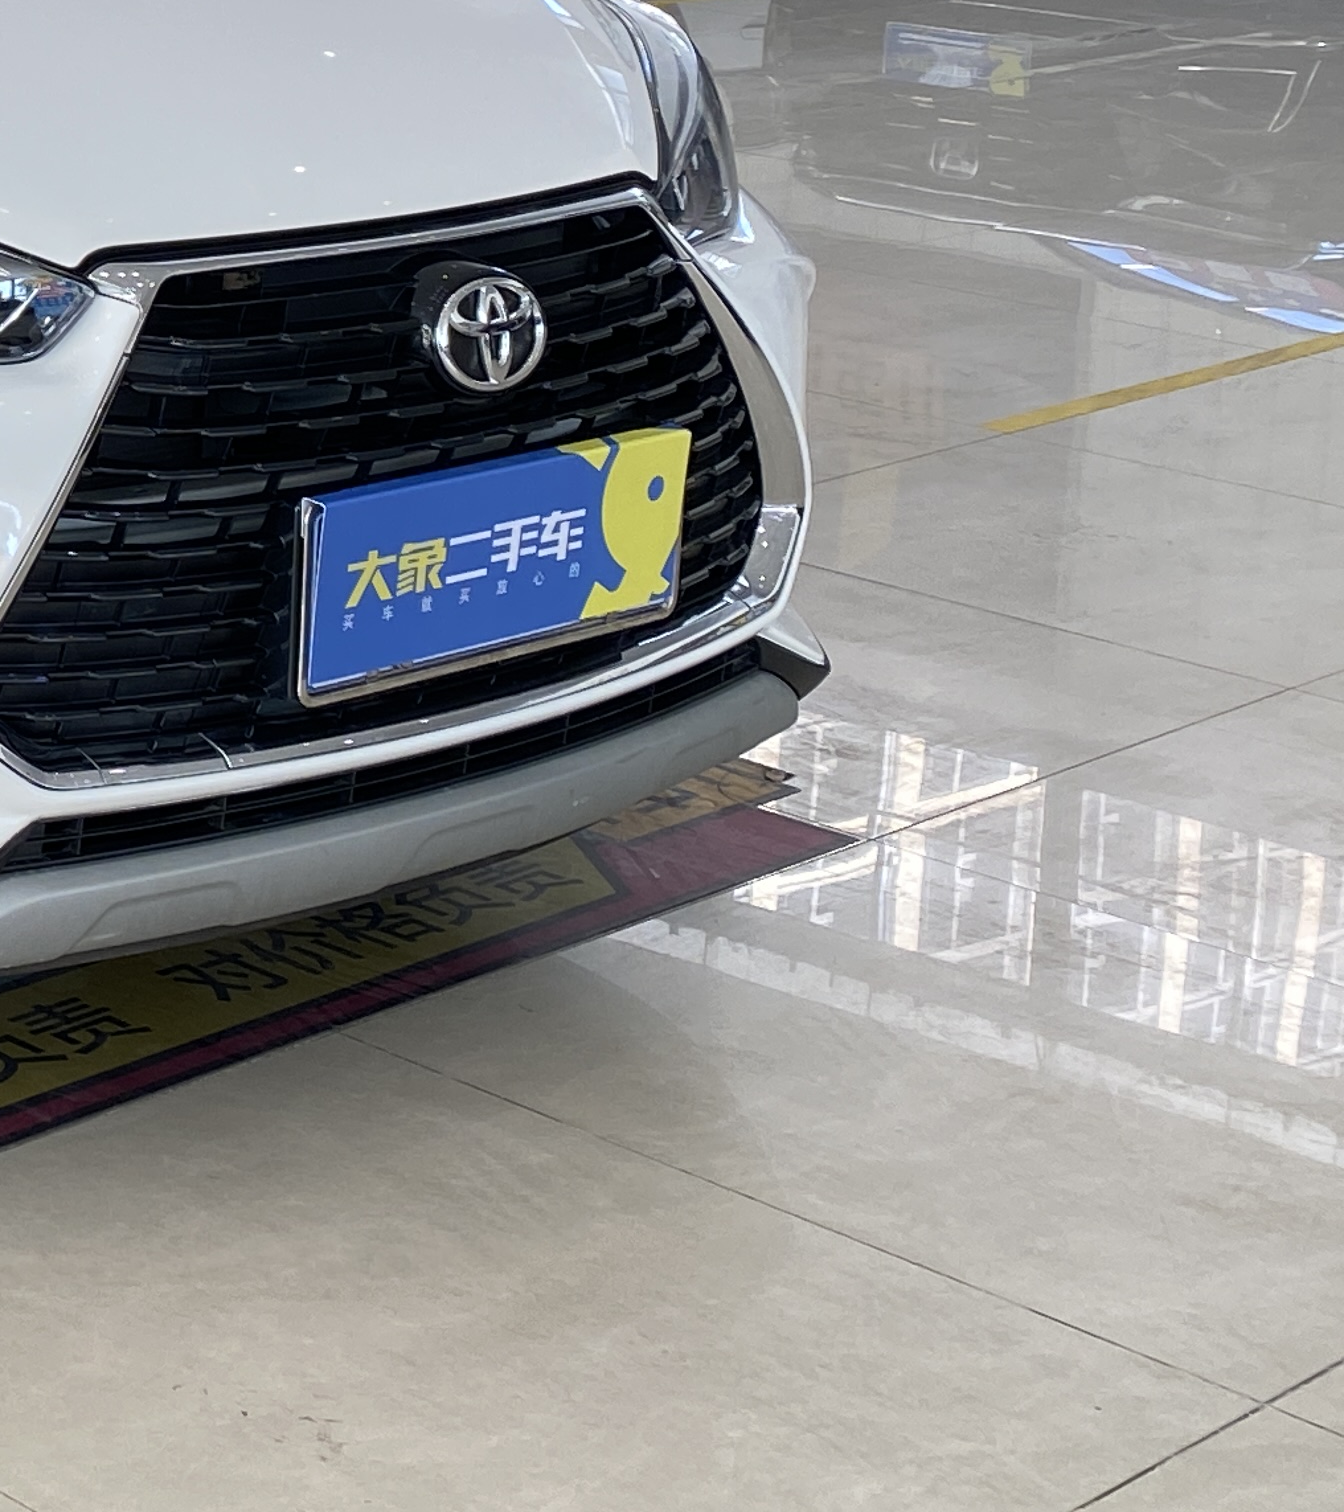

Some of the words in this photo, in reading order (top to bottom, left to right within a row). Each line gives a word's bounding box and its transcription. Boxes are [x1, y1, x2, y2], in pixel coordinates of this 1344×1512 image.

[342, 561, 581, 632] 买车就买放心的
[344, 507, 587, 610] 大象二手车
[156, 859, 585, 1002] 对价格负责
